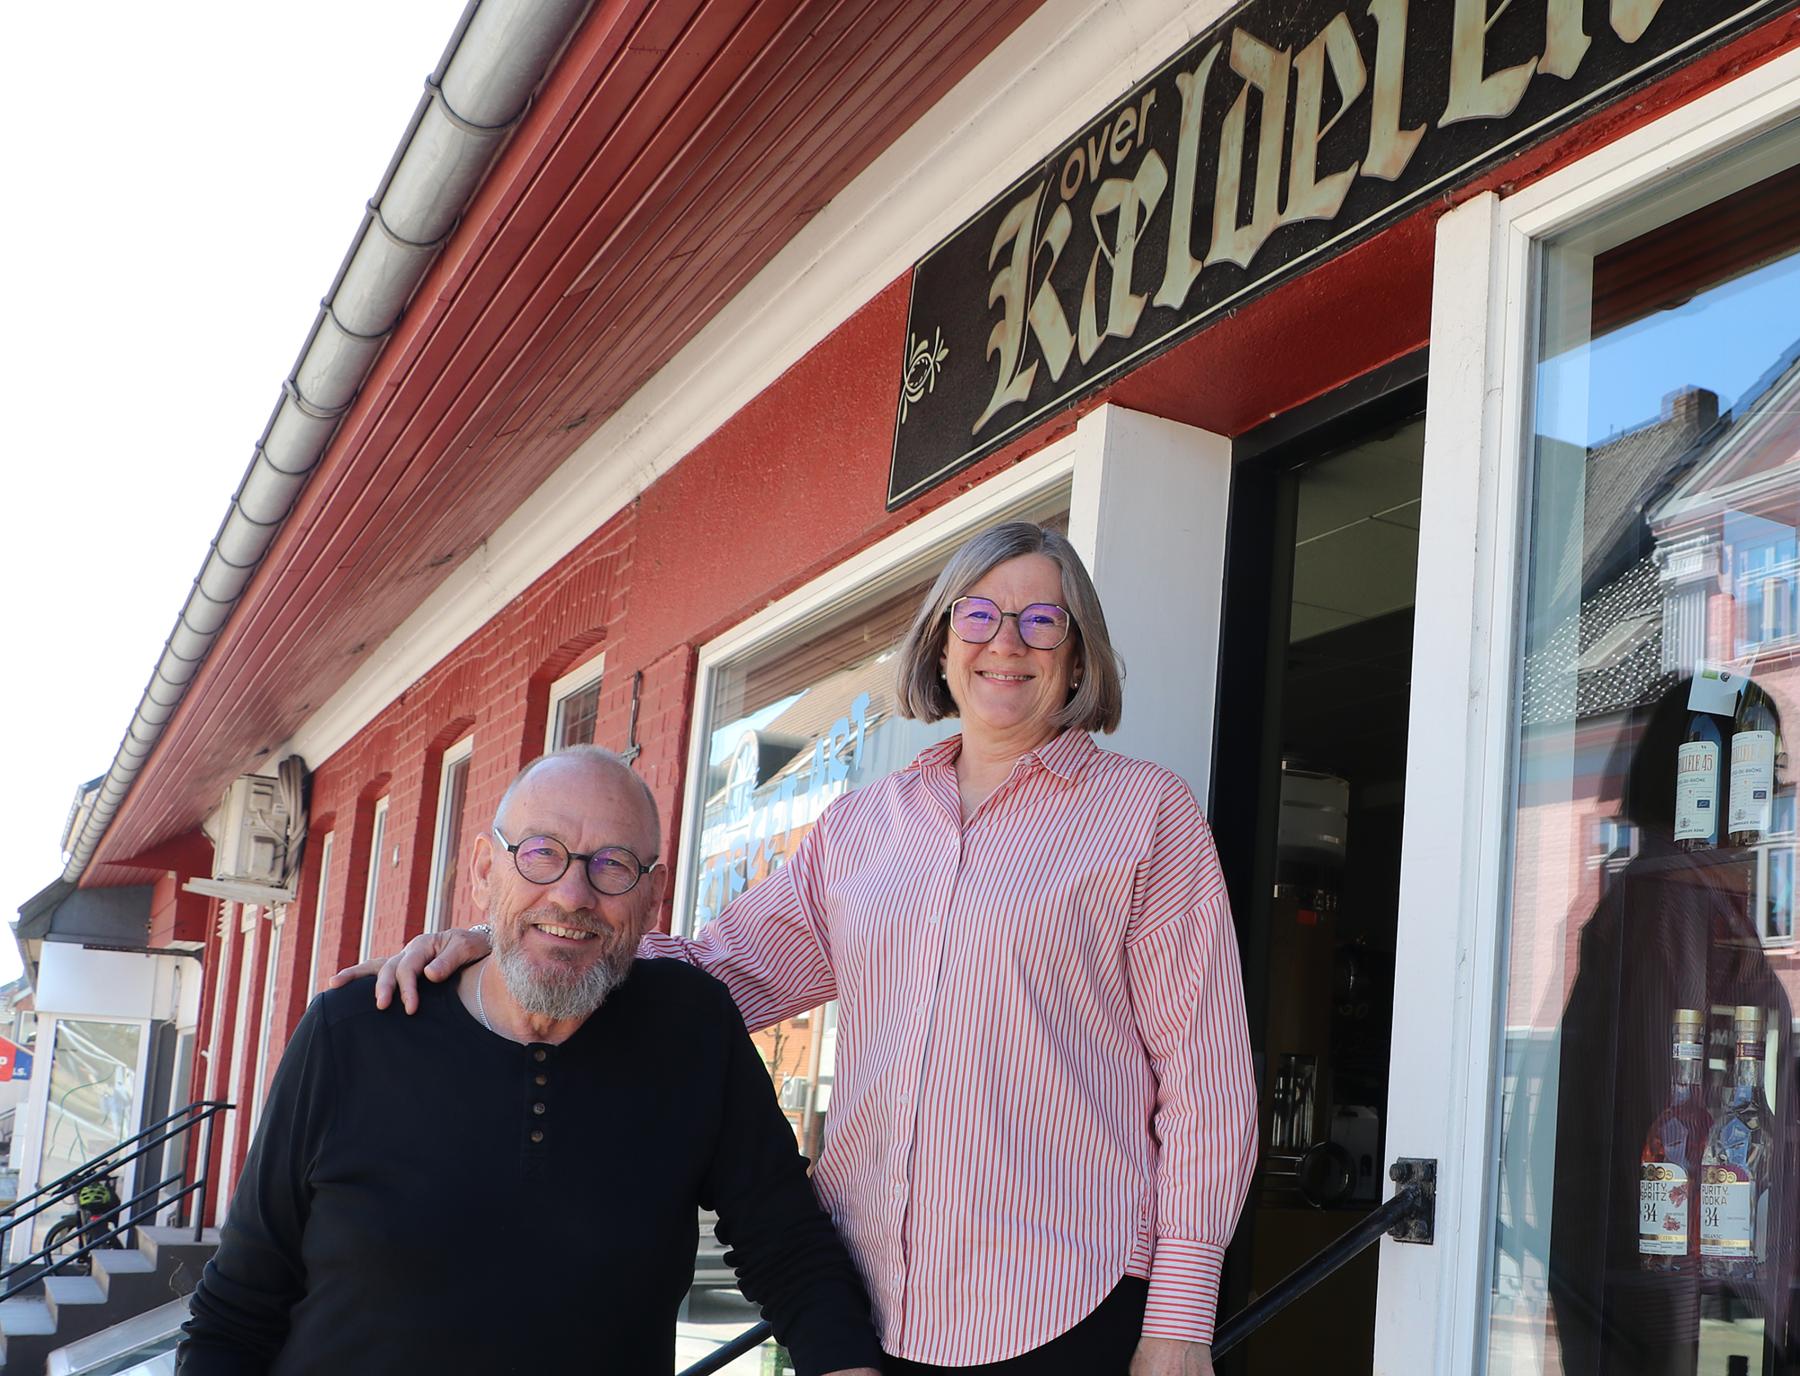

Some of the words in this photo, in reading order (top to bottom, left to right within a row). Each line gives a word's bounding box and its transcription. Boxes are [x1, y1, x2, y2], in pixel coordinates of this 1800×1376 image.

[1061, 88, 1157, 200] over
[1702, 754, 1712, 771] 45
[1643, 1202, 1658, 1222] 34
[1704, 1207, 1720, 1227] 34
